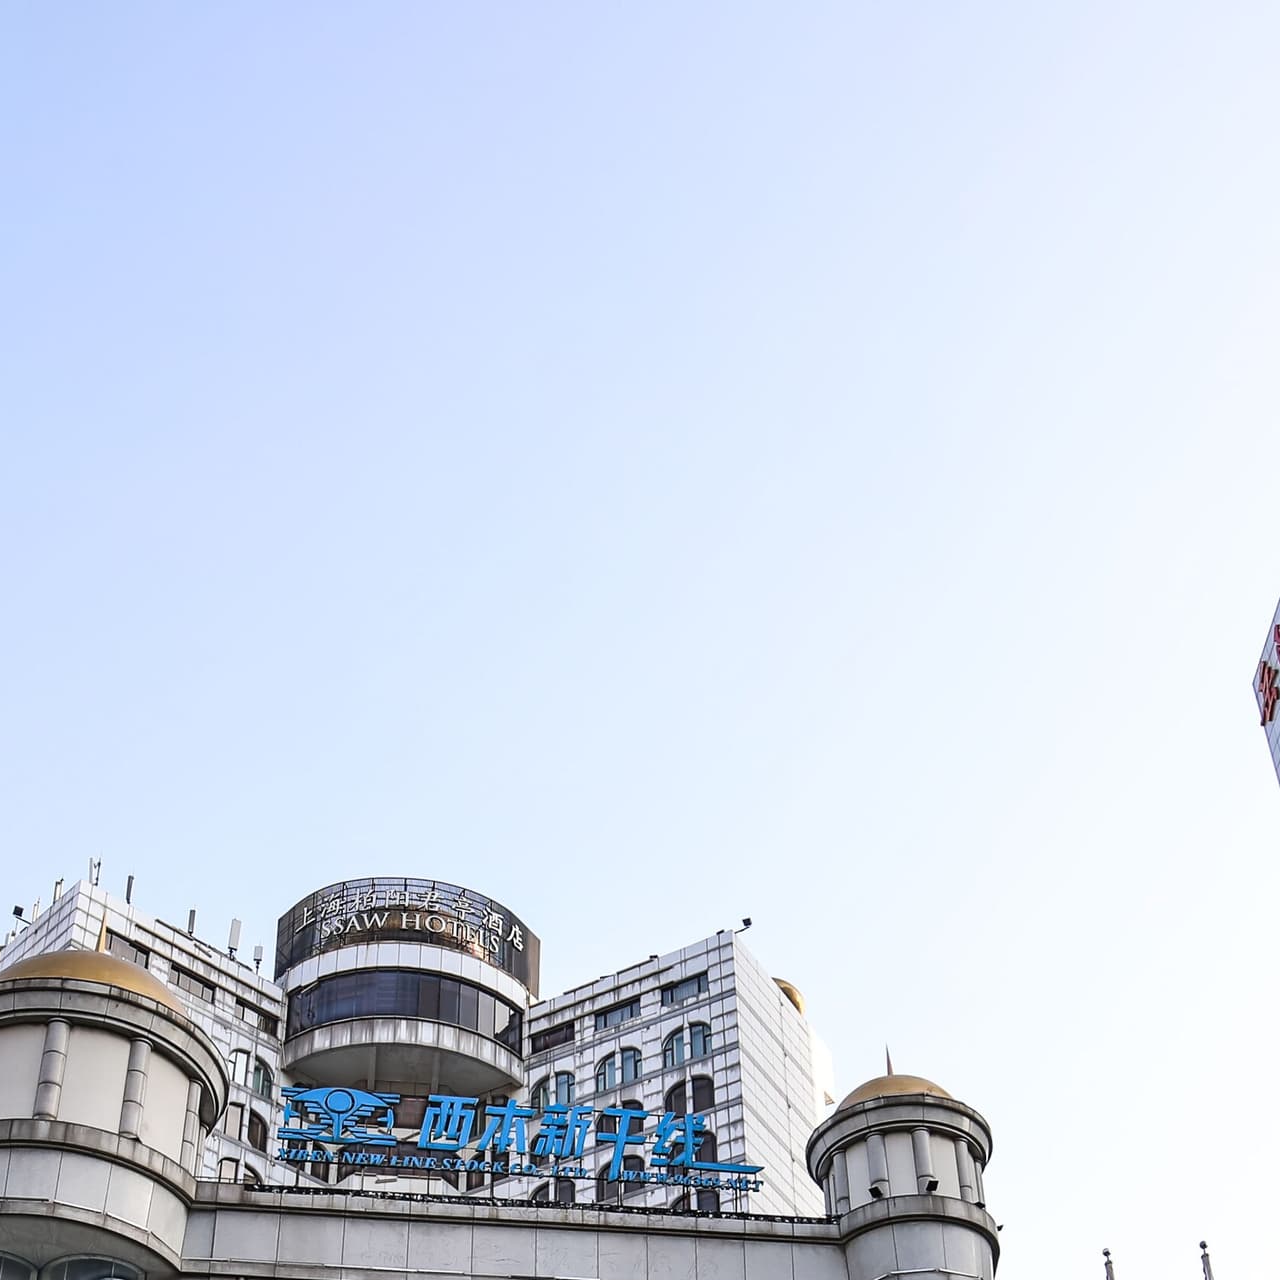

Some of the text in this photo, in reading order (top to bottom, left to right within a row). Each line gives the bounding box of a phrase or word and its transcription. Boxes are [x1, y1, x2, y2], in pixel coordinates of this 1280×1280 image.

[294, 888, 525, 952] 上海柏阳君亭酒店
[320, 911, 500, 953] SSAW HOTELS
[277, 1148, 335, 1162] XIBEN
[342, 1152, 386, 1166] NEW
[390, 1155, 438, 1170] LINE
[440, 1158, 505, 1173] STOCK
[417, 1094, 765, 1183] 西本新干线
